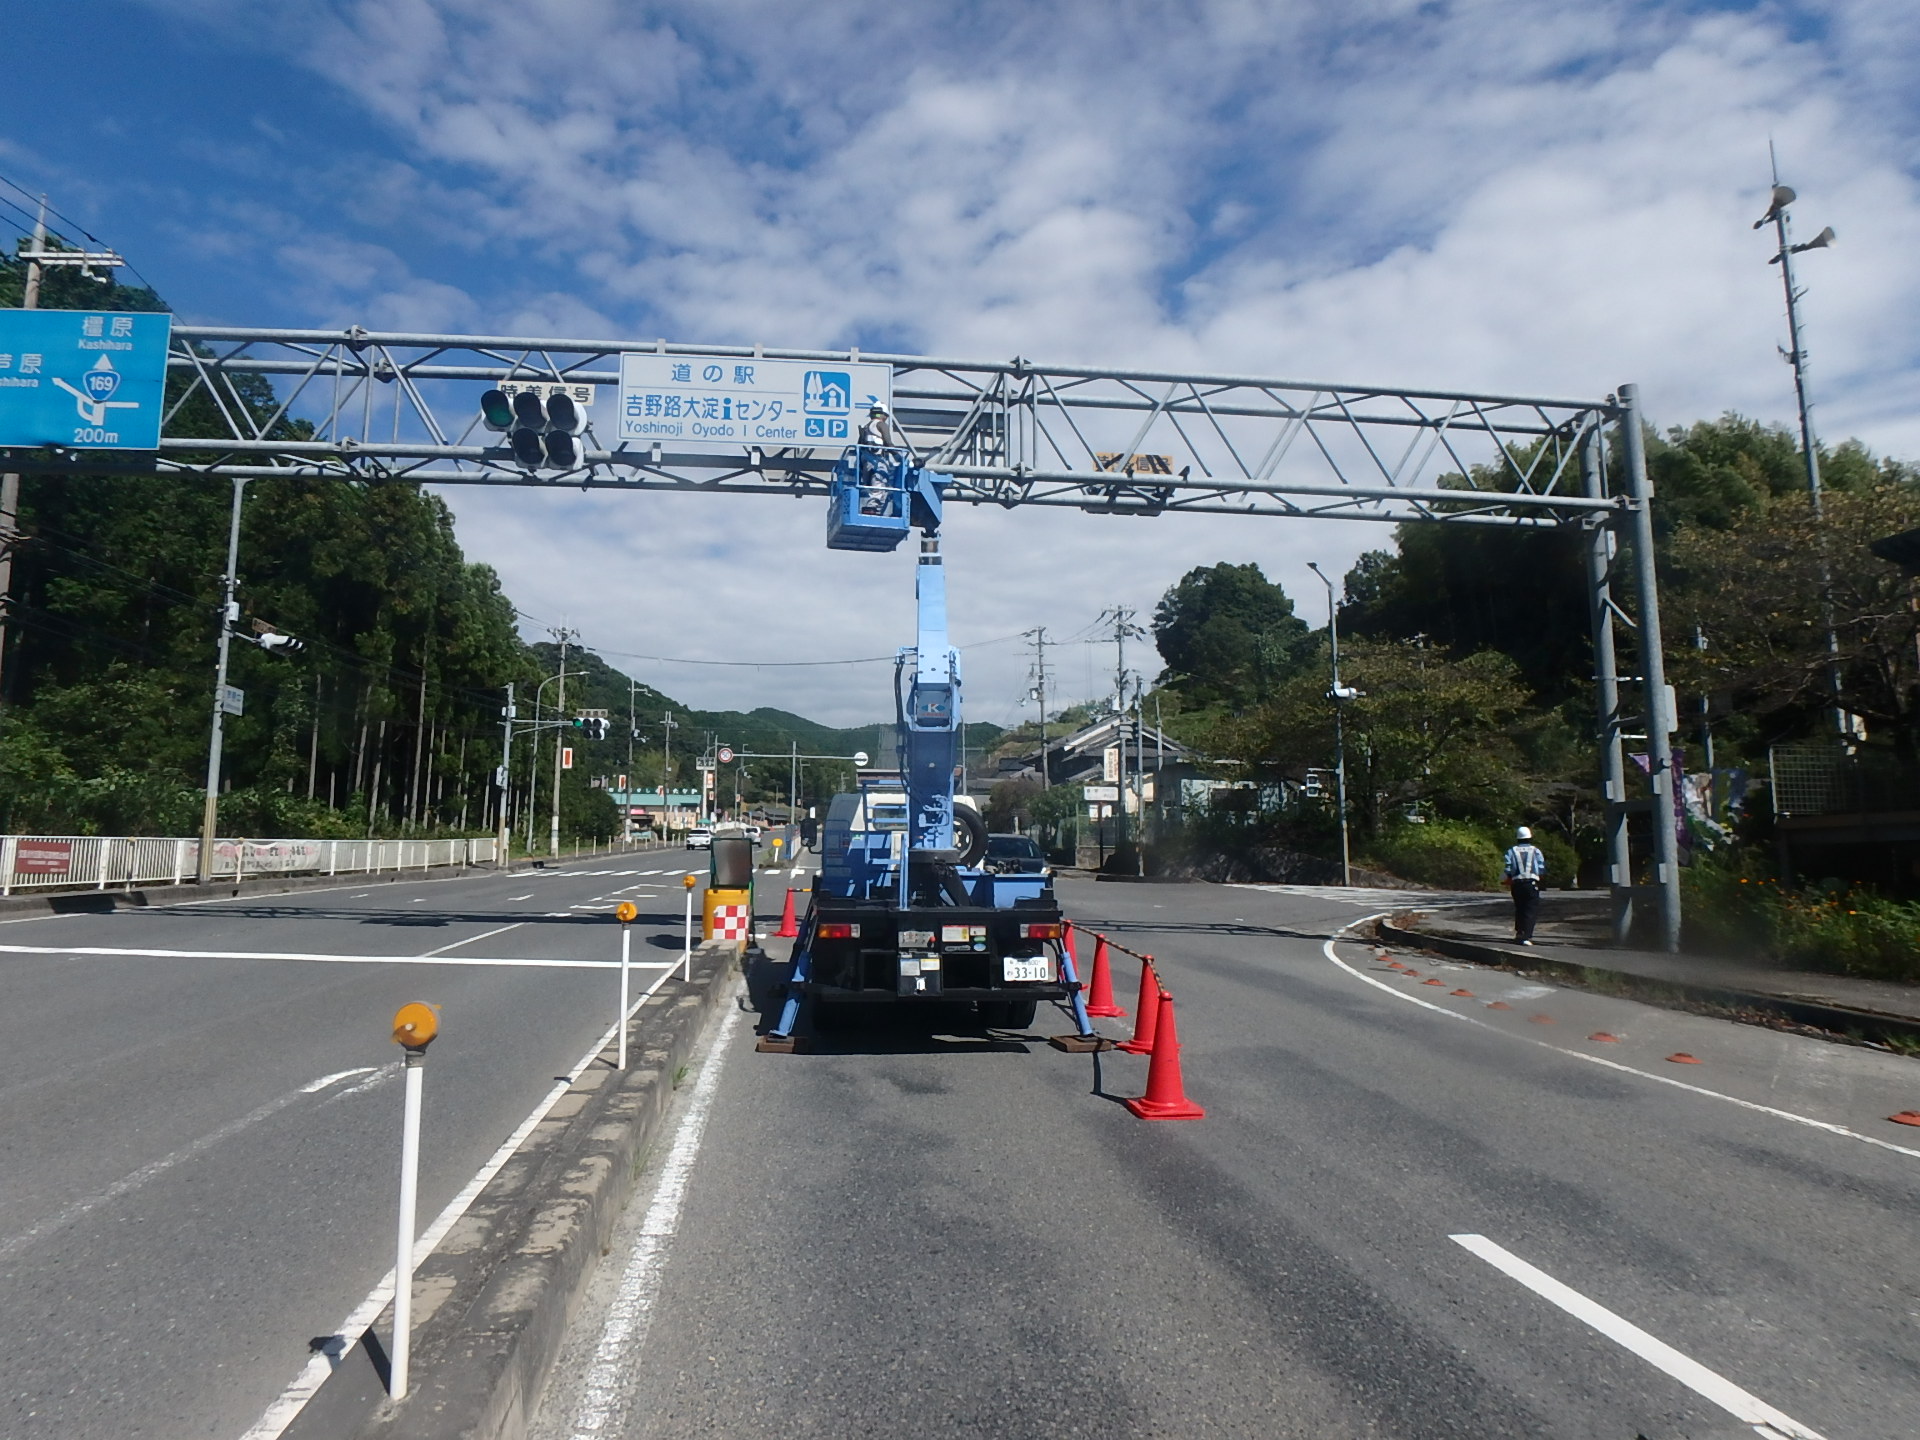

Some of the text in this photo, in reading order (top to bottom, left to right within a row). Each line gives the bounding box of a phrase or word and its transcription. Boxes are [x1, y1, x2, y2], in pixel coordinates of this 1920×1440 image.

[82, 316, 133, 337] 橿原
[78, 339, 133, 351] Kashihara
[671, 363, 754, 385] 道の駅
[89, 376, 114, 391] 169
[74, 427, 119, 444] 200m
[625, 420, 683, 437] Yoshinoji
[692, 422, 735, 438] Oyodo
[756, 424, 798, 439] Center
[832, 421, 845, 436] P
